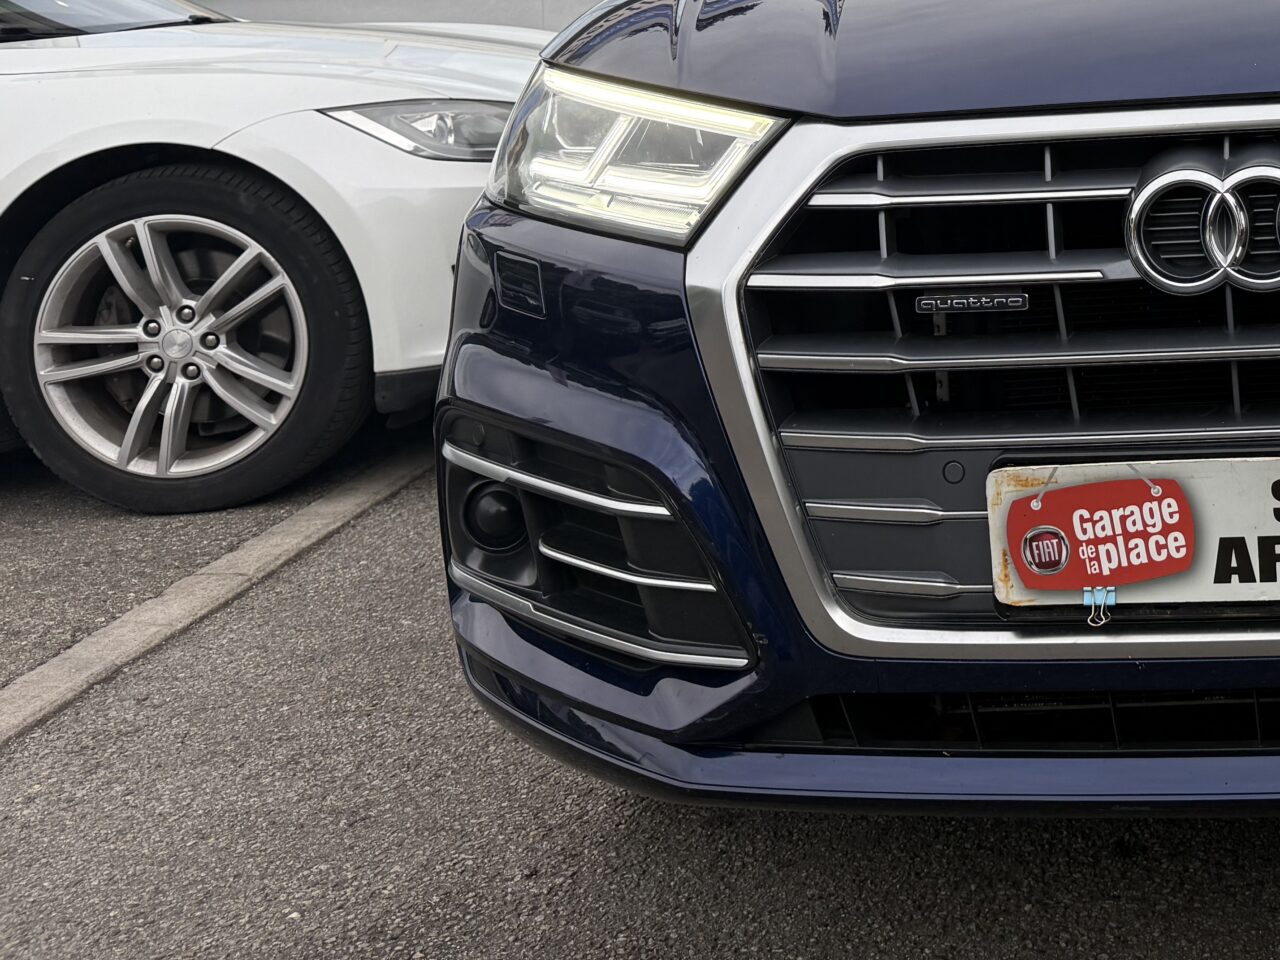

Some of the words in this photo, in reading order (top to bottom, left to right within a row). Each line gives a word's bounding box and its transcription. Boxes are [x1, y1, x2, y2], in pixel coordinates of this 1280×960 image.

[920, 296, 1023, 311] quattro
[1071, 497, 1180, 541] Garage
[1031, 538, 1060, 564] FIAT
[1078, 542, 1096, 559] de
[1086, 558, 1100, 575] la
[1098, 531, 1187, 576] place
